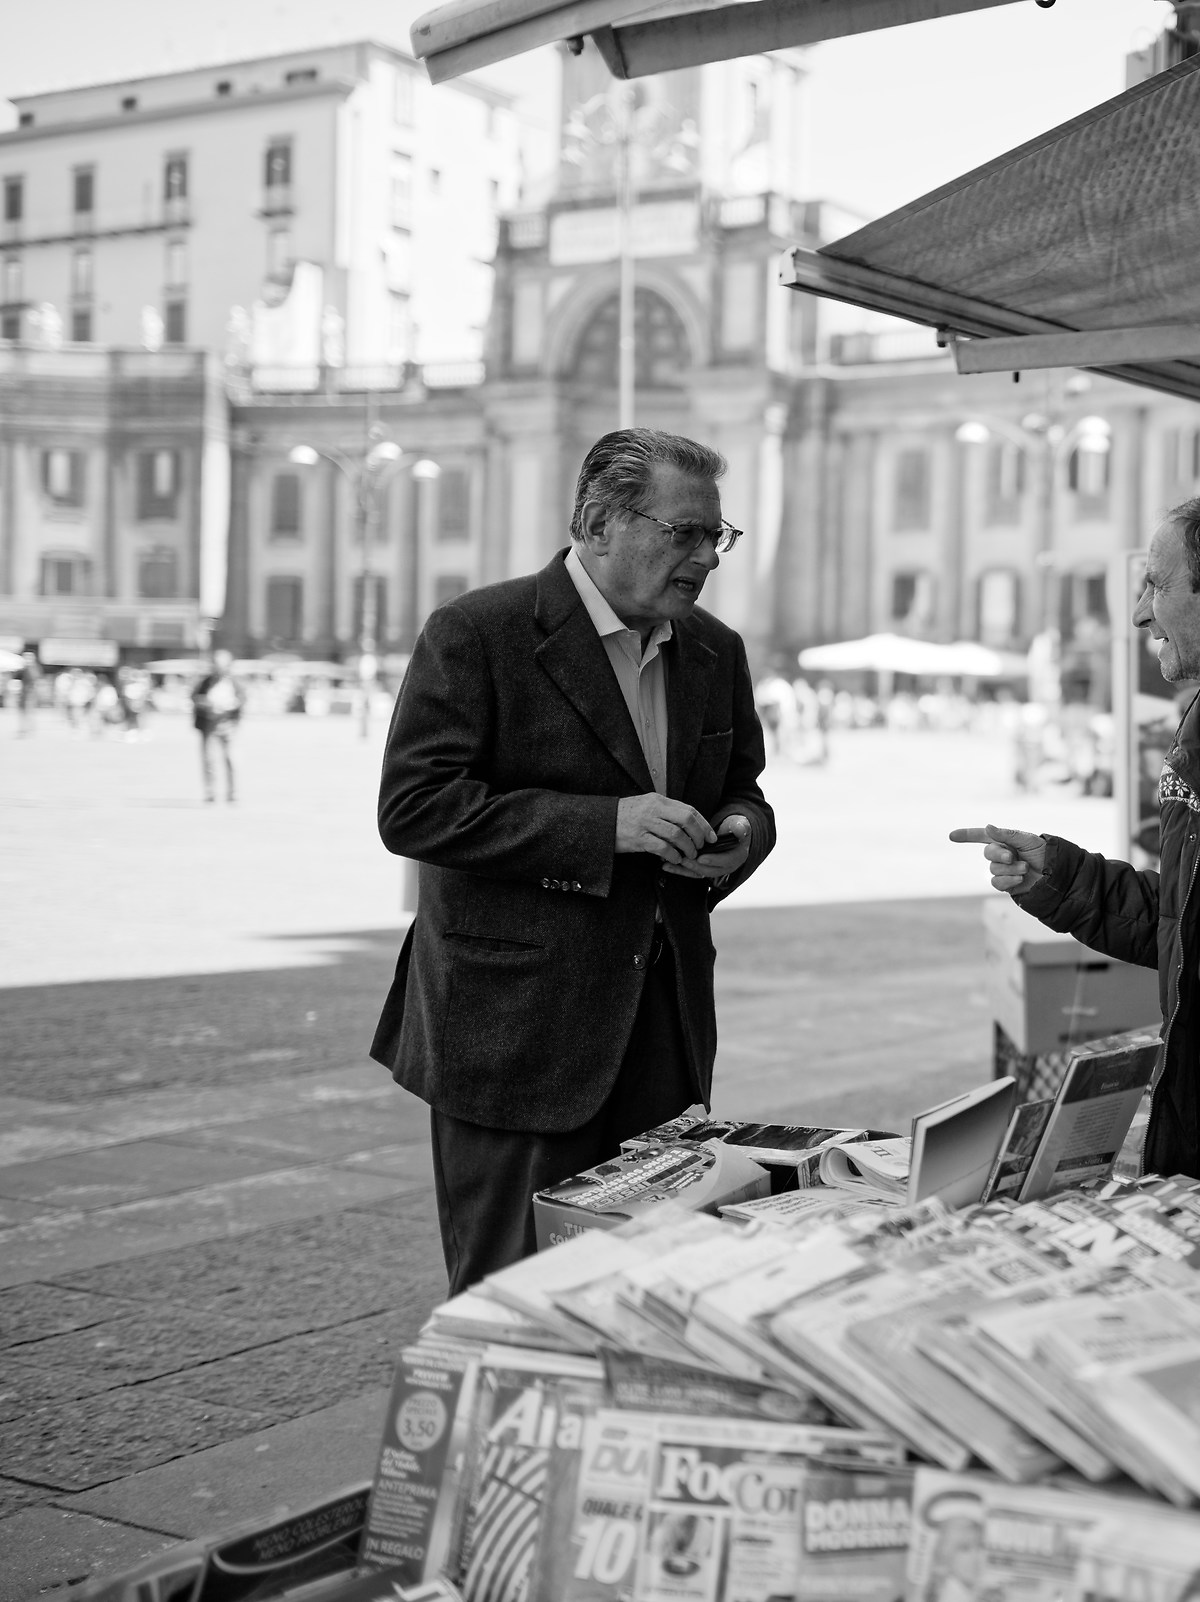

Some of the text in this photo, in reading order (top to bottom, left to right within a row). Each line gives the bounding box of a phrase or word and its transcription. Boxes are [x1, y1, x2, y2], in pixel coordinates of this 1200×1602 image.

[378, 1480, 437, 1500] ANTEPRIMA
[366, 1538, 424, 1561] IN REGALO
[573, 1519, 638, 1585] 10
